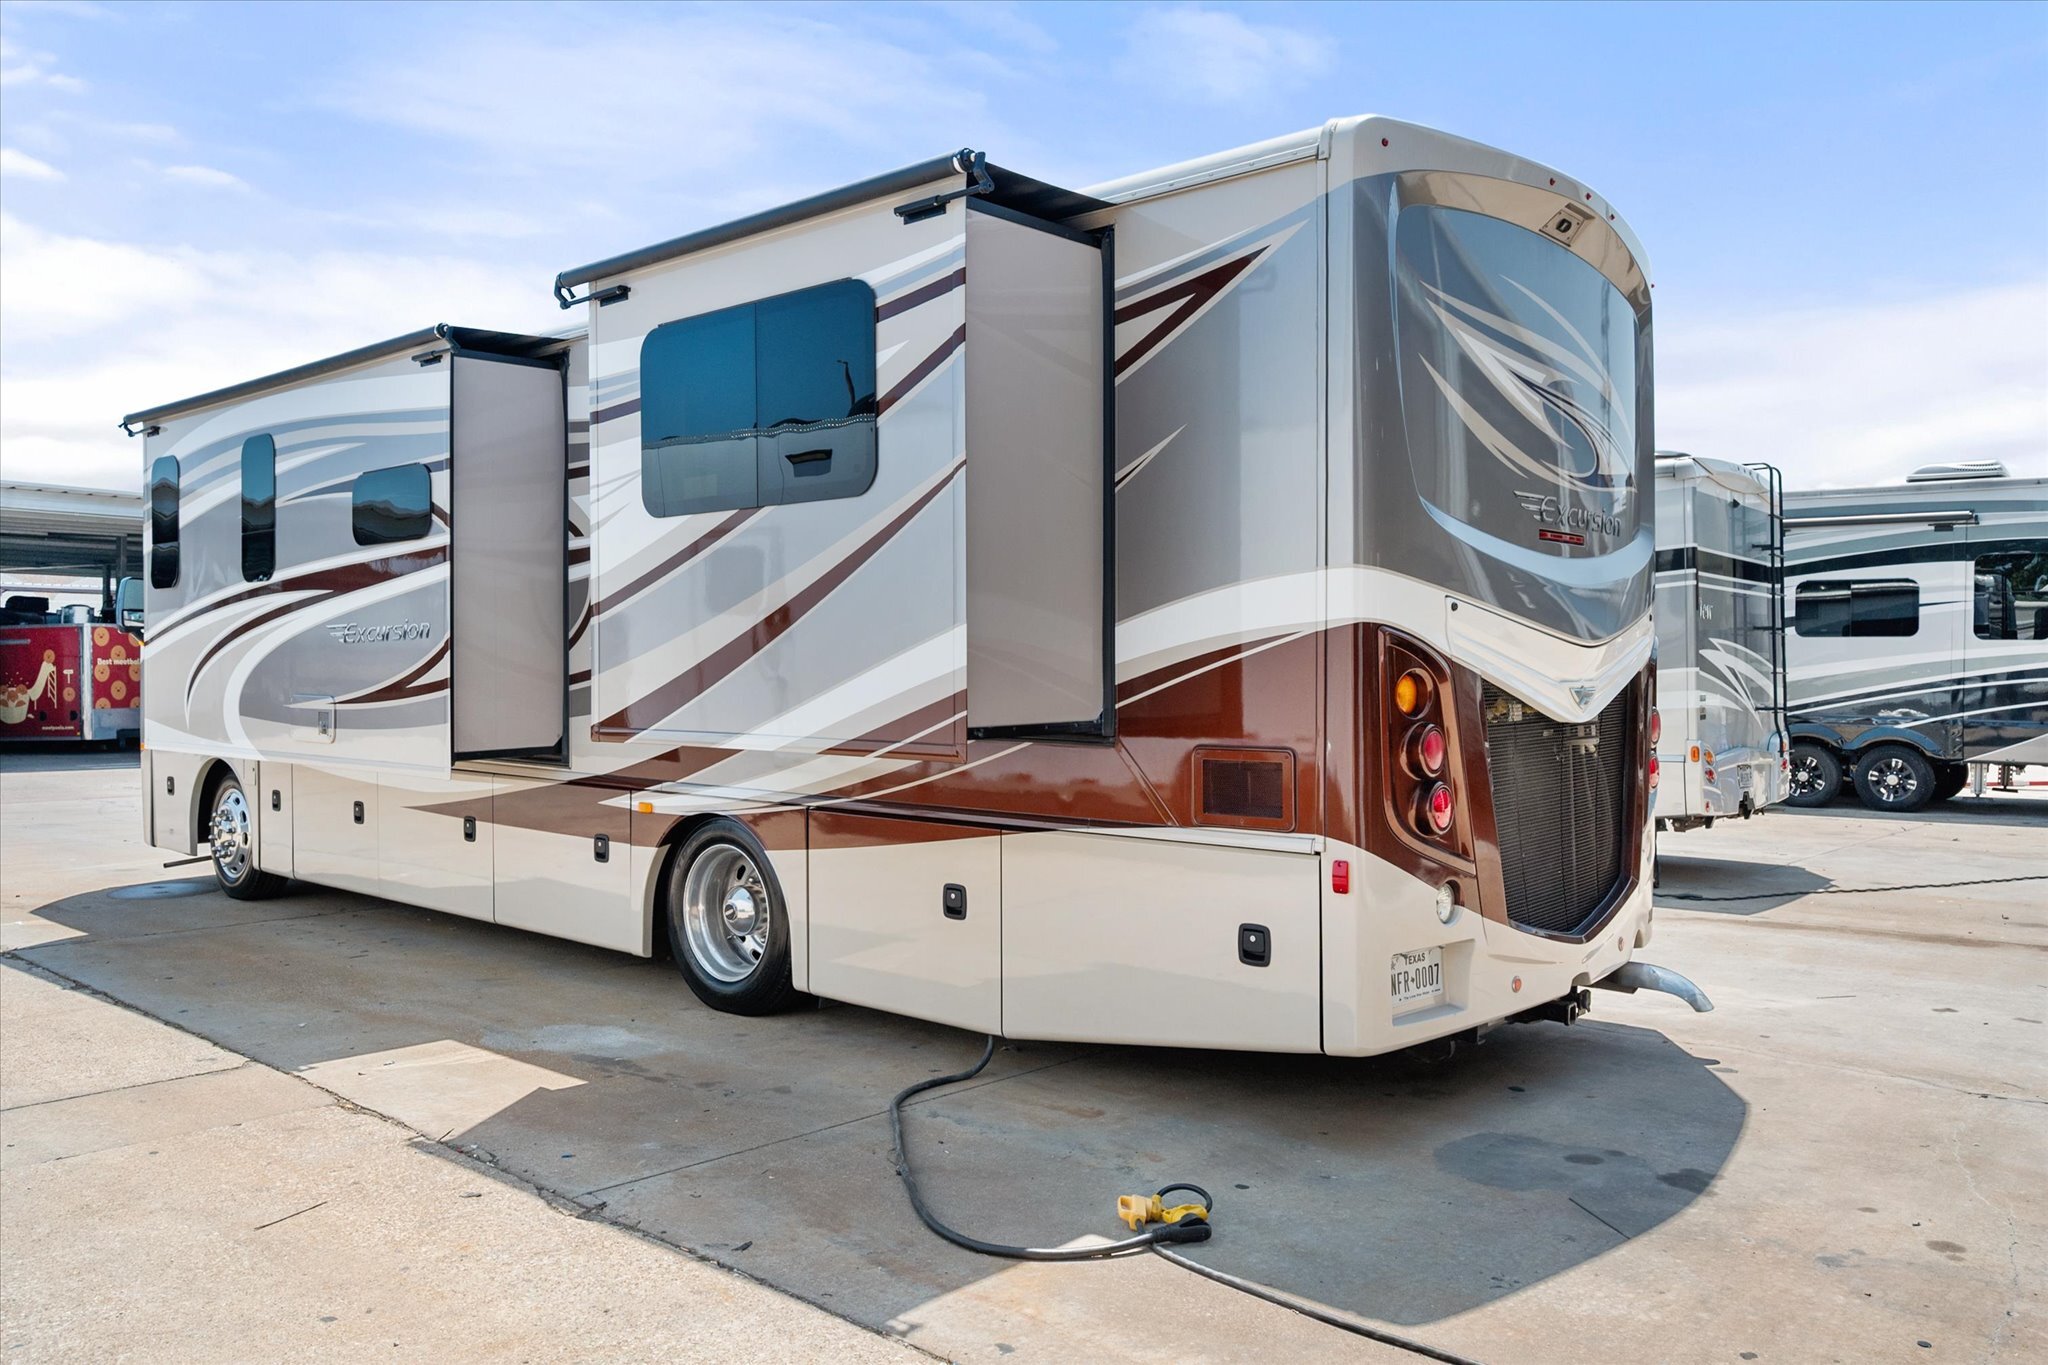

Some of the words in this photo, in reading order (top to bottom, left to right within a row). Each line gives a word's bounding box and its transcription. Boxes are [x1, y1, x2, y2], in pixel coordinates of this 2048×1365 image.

[1540, 496, 1622, 537] Excursion
[342, 618, 431, 644] Excursion
[1404, 952, 1426, 965] TEXAS
